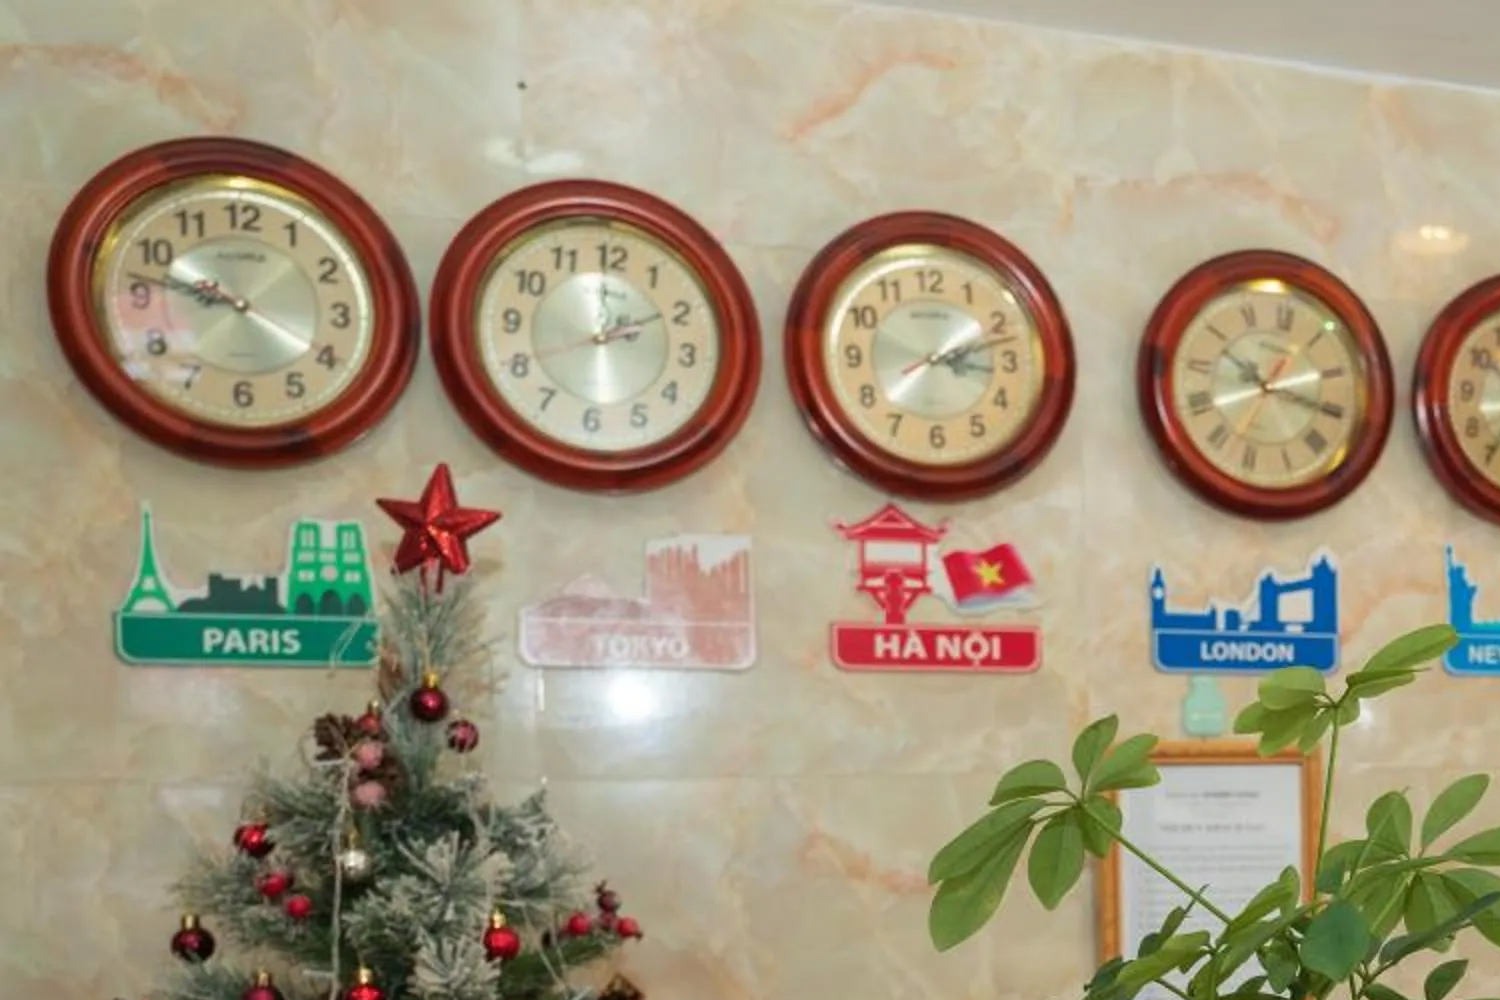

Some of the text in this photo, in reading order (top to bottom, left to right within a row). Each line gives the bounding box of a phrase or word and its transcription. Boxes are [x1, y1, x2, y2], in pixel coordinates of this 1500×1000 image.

[175, 210, 206, 238] 11
[224, 203, 261, 232] 12
[285, 221, 298, 247] 1
[139, 238, 173, 266] 10
[551, 246, 577, 272] 11
[595, 244, 629, 271] 12
[318, 257, 338, 284] 2
[647, 266, 659, 289] 1
[915, 270, 945, 294] 12
[130, 282, 150, 309] 9
[515, 270, 546, 297] 10
[876, 280, 900, 302] 11
[961, 283, 973, 305] 1
[331, 303, 351, 328] 3
[502, 308, 522, 334] 9
[672, 301, 691, 326] 2
[850, 306, 878, 329] 10
[990, 311, 1006, 334] 2
[147, 330, 167, 356] 8
[677, 343, 696, 368] 3
[315, 345, 337, 370] 4
[510, 353, 530, 378] 8
[845, 344, 862, 368] 9
[1002, 350, 1018, 374] 3
[180, 364, 200, 389] 7
[286, 372, 305, 398] 5
[233, 380, 254, 408] 6
[538, 387, 557, 411] 7
[660, 381, 679, 404] 4
[860, 384, 876, 408] 8
[992, 388, 1008, 410] 4
[1460, 380, 1475, 400] 9
[582, 408, 602, 433] 6
[629, 404, 649, 428] 5
[886, 414, 903, 437] 7
[969, 414, 986, 438] 5
[1465, 417, 1480, 438] 8
[928, 426, 946, 449] 6
[202, 628, 301, 654] PARIS
[936, 631, 1003, 667] NỘI
[1200, 641, 1295, 662] LONDON
